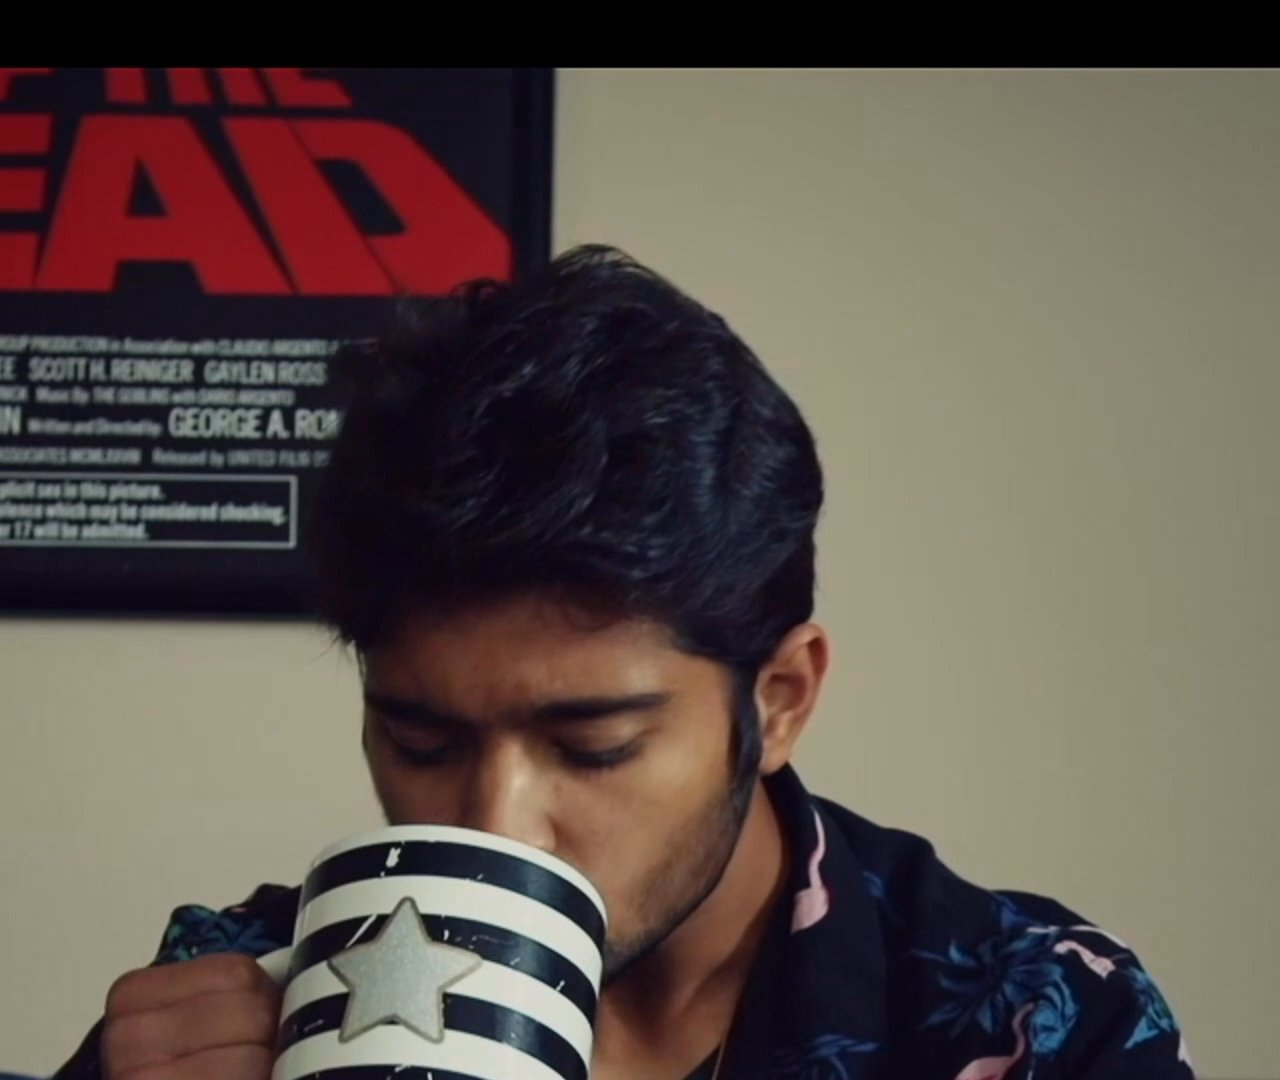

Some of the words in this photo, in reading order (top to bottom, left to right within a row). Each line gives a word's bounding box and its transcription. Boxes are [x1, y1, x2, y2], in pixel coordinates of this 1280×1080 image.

[28, 357, 88, 381] SCOTT
[110, 359, 195, 383] REINIGER
[204, 360, 276, 384] GAYLEN
[277, 361, 328, 385] ROSS
[168, 408, 264, 438] GEORGE
[265, 409, 291, 439] A.
[63, 482, 78, 499] in
[79, 482, 108, 499] this
[108, 482, 166, 502] picture.
[45, 502, 88, 520] which
[88, 504, 118, 524] may
[119, 503, 138, 521] be
[139, 503, 219, 521] considered
[219, 502, 288, 526] shocking.
[13, 521, 32, 539] 17
[33, 521, 61, 539] will
[61, 521, 80, 539] be
[81, 522, 150, 540] admitted.
